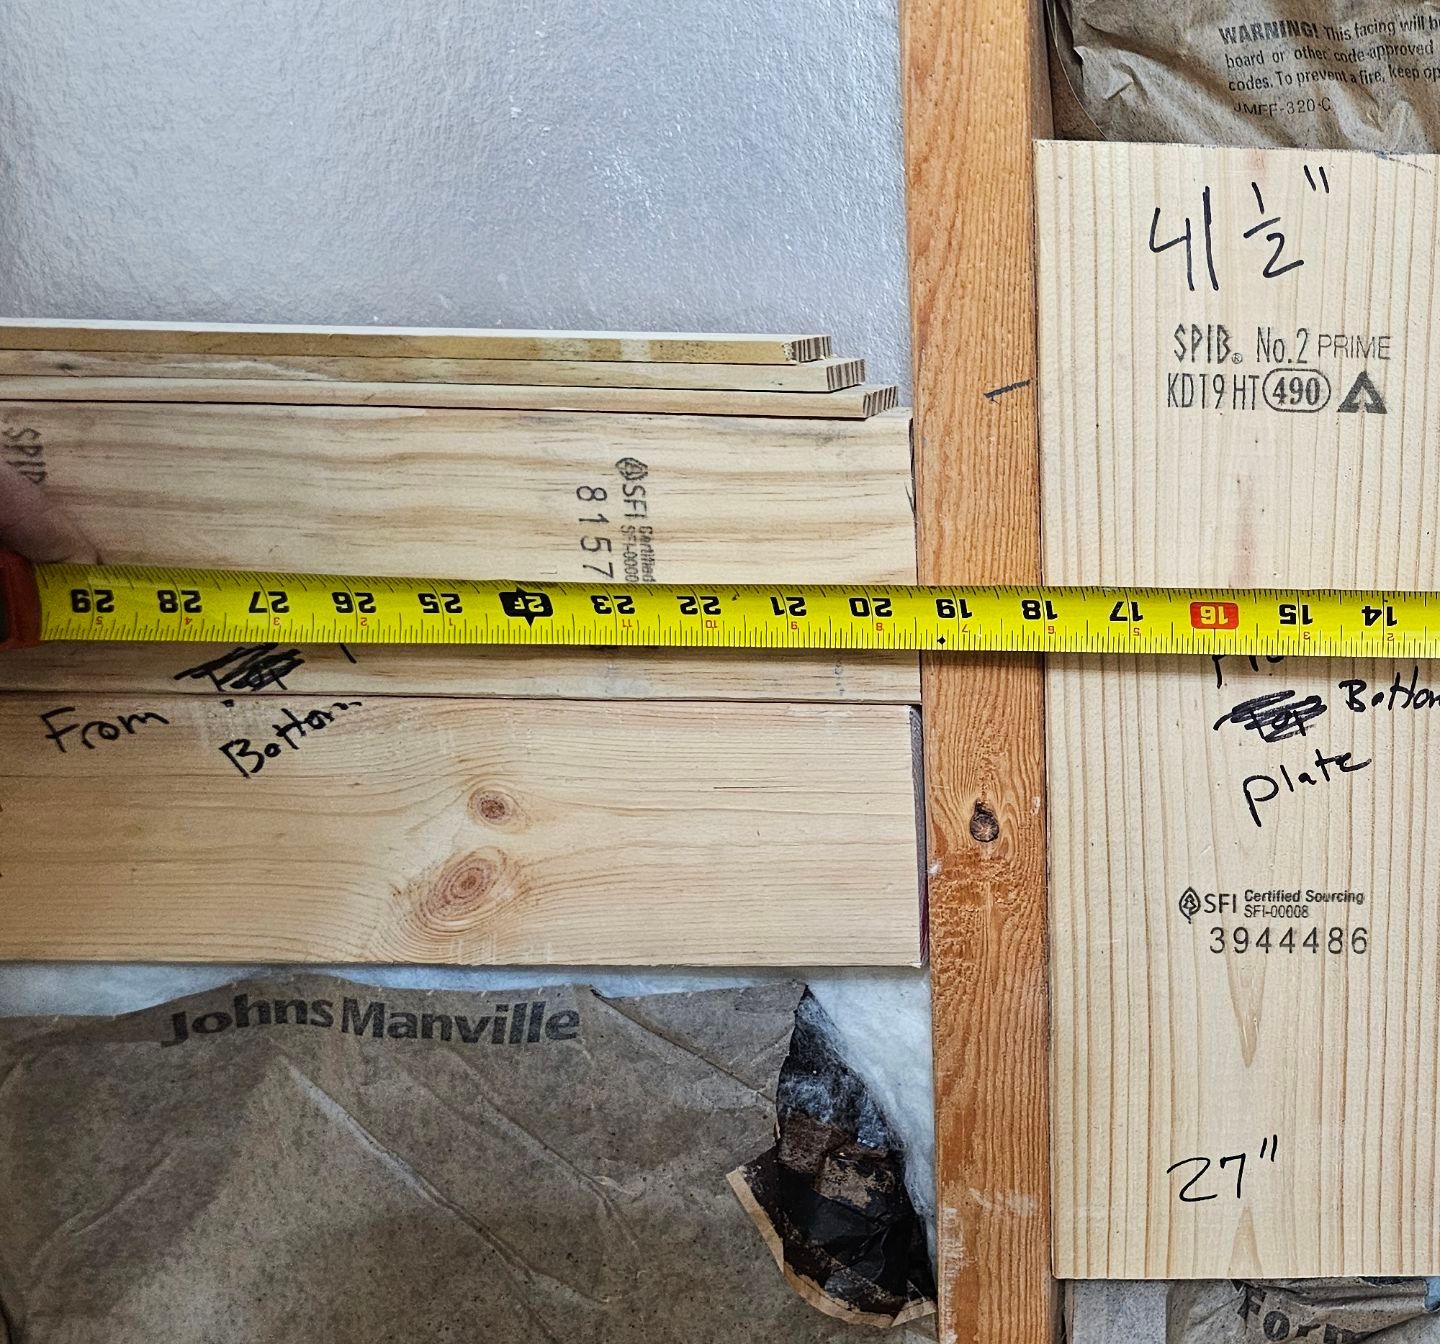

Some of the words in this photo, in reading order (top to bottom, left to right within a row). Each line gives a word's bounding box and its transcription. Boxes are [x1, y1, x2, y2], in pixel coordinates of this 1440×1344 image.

[1218, 19, 1320, 45] WARNING!
[1324, 24, 1352, 41] This
[1354, 19, 1396, 38] facing
[1400, 15, 1425, 32] will
[1225, 50, 1265, 69] board
[1272, 51, 1286, 64] or
[1294, 45, 1328, 61] other
[1333, 39, 1434, 63] code-approved
[1228, 74, 1274, 92] codes.
[1275, 70, 1293, 86] To
[1296, 68, 1348, 87] prevent
[1350, 73, 1357, 84] a
[1360, 69, 1386, 85] fire,
[1388, 63, 1420, 81] keep
[1148, 185, 1219, 292] 41
[1318, 333, 1392, 361] PRIME
[1271, 375, 1323, 407] 490
[621, 483, 648, 520] SFI
[575, 485, 615, 580] 8157
[620, 524, 640, 583] SFI-0000
[70, 588, 115, 613] 29
[157, 589, 202, 614] 28
[248, 591, 290, 614] 27
[332, 591, 376, 614] 26
[417, 592, 463, 614] 25
[590, 594, 636, 615] 23
[676, 595, 722, 616] 22
[770, 596, 807, 617] 21
[848, 597, 893, 618] 20
[936, 598, 973, 619] 19
[1021, 599, 1058, 620] 18
[1109, 601, 1144, 622] 17
[1200, 605, 1229, 625] 16
[1279, 604, 1313, 625] 15
[1361, 605, 1398, 627] 14
[40, 705, 170, 753] From
[1203, 893, 1237, 914] SFI
[1243, 889, 1301, 903] Certified
[1305, 889, 1365, 906] Sourcing
[1243, 904, 1310, 919] SFI-00008
[1209, 926, 1369, 955] 3944486
[160, 994, 335, 1049] Johns
[341, 996, 582, 1045] Manville
